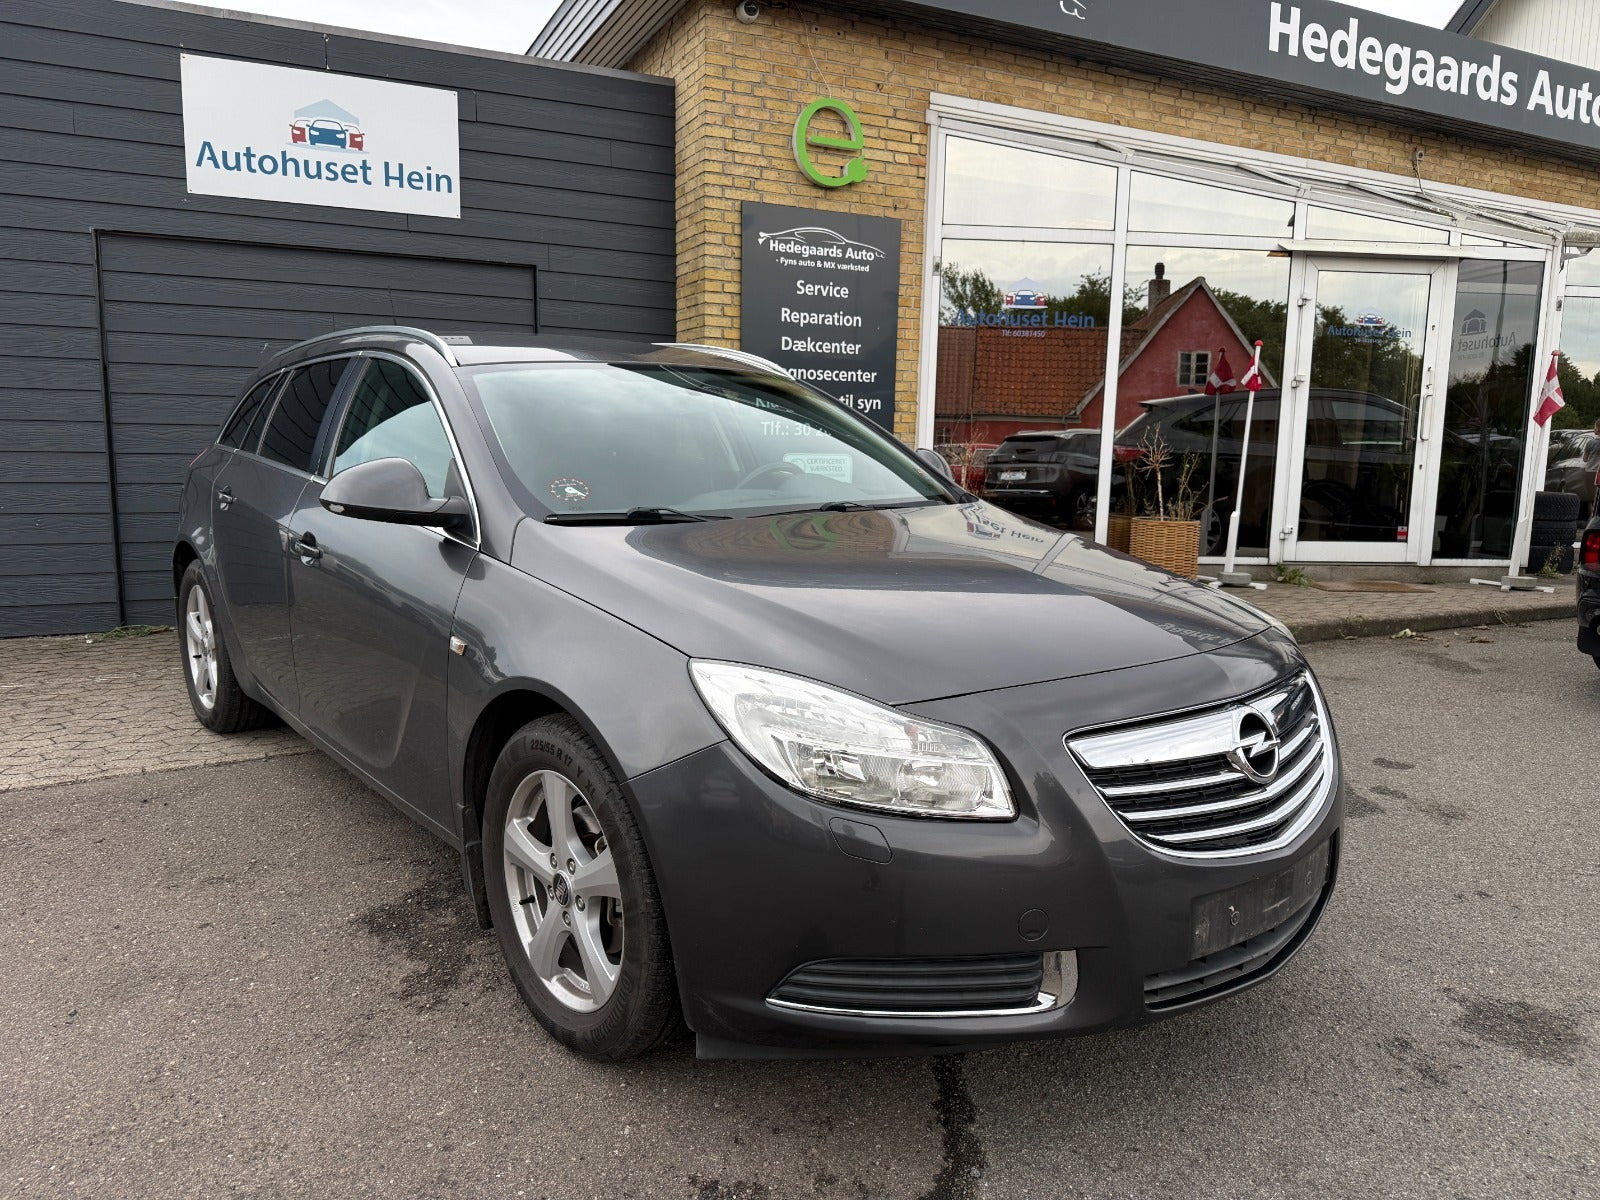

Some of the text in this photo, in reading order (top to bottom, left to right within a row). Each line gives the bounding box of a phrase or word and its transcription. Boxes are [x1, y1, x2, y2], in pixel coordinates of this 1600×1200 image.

[1268, 1, 1519, 106] Hedegaards
[195, 140, 453, 194] Autohuset Hein
[769, 239, 875, 261] Hedegaards Auto
[780, 257, 797, 266] Fyns
[816, 260, 822, 268] &
[823, 261, 836, 269] MX
[837, 262, 870, 272] værksted
[796, 279, 849, 298] Service
[781, 307, 862, 327] Reparation
[954, 309, 1096, 329] Autohuset Hein
[781, 336, 862, 355] Dækcenter
[839, 394, 882, 413] til syn
[794, 422, 811, 437] 30
[530, 738, 555, 756] 225/55
[556, 747, 563, 761] R
[564, 754, 574, 767] 17
